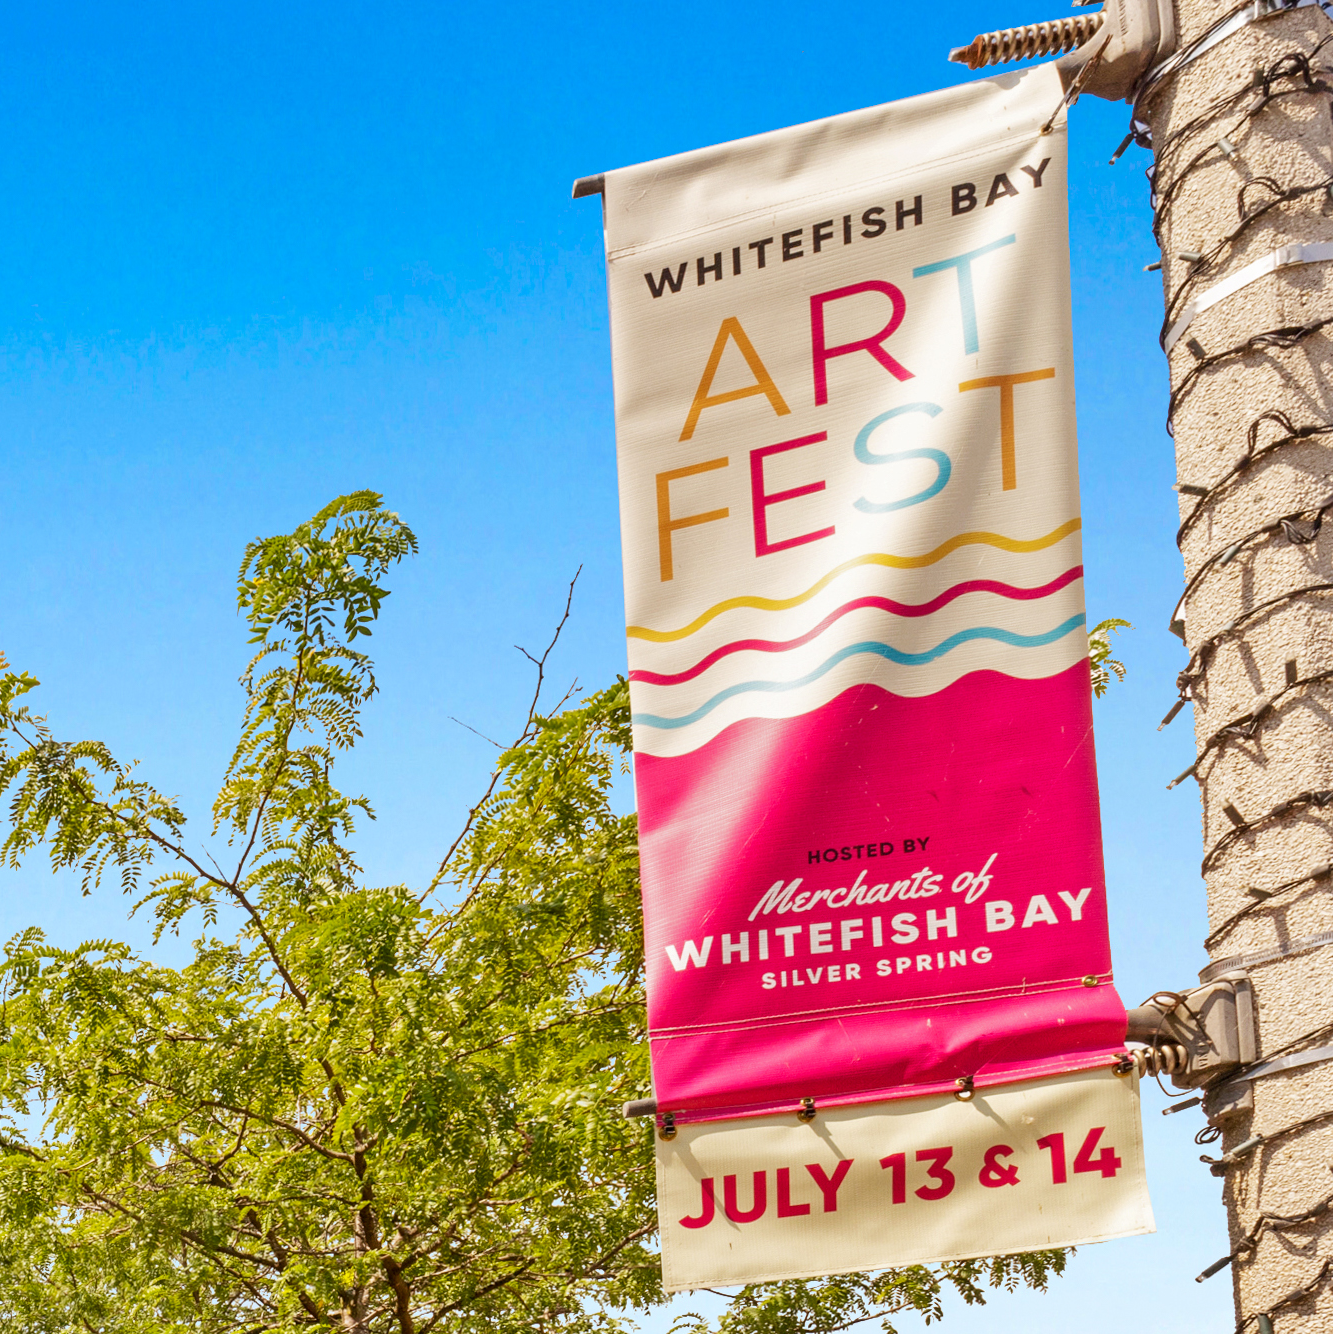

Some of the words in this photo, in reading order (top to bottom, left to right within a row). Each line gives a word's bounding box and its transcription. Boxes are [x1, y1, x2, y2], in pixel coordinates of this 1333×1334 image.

[644, 195, 923, 299] WHITEFISH
[951, 157, 1052, 216] BAY
[678, 233, 1017, 442] ART
[655, 367, 1056, 582] FEST
[747, 867, 942, 922] Merchants
[951, 853, 998, 904] of
[808, 841, 894, 864] HOSTED
[904, 837, 931, 854] BY
[665, 907, 958, 972] WHITEFISH
[986, 887, 1092, 933] BAY
[761, 964, 861, 990] SILVER
[876, 947, 993, 977] SPRING
[678, 1159, 854, 1229] JULY
[879, 1146, 955, 1205] 13
[978, 1144, 1021, 1188] &
[1036, 1126, 1122, 1184] 14
